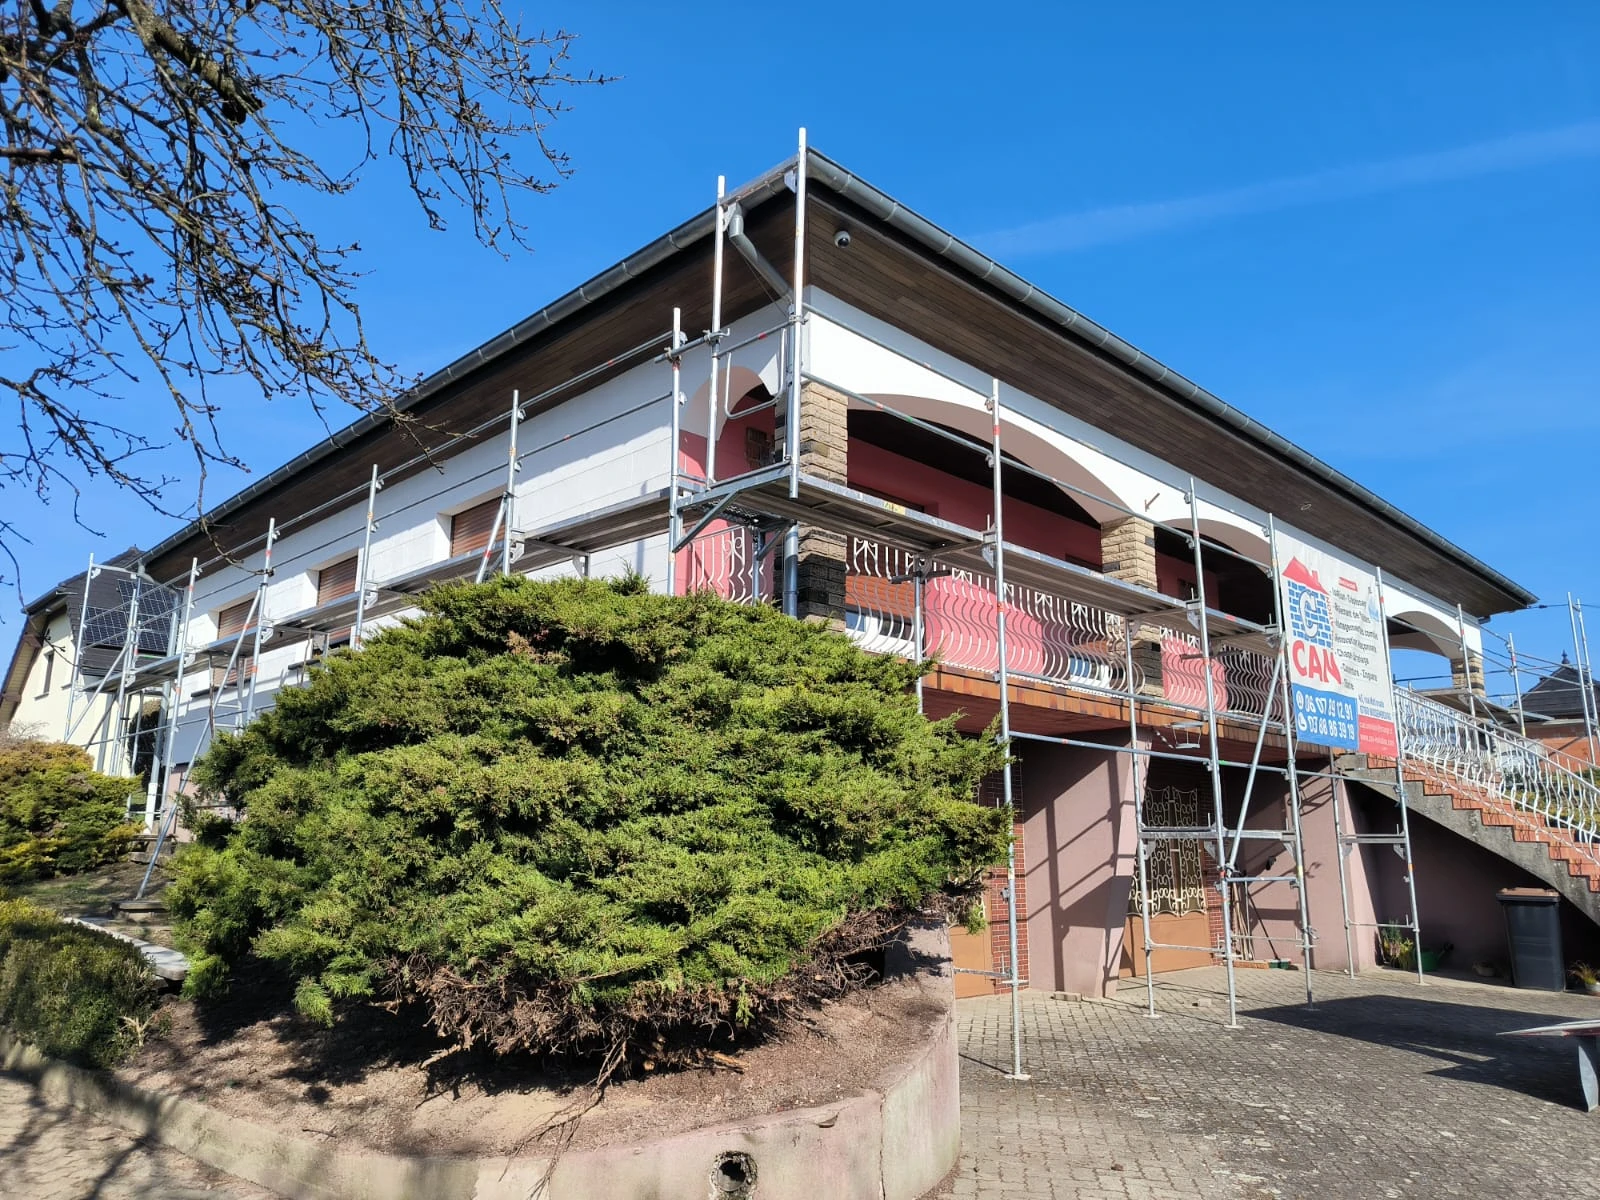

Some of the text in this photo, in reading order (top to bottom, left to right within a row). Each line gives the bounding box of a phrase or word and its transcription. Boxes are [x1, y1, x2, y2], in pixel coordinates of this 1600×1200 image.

[1292, 640, 1342, 685] CAN
[1305, 694, 1316, 713] 06
[1315, 696, 1327, 715] 07
[1307, 715, 1318, 734] 03
